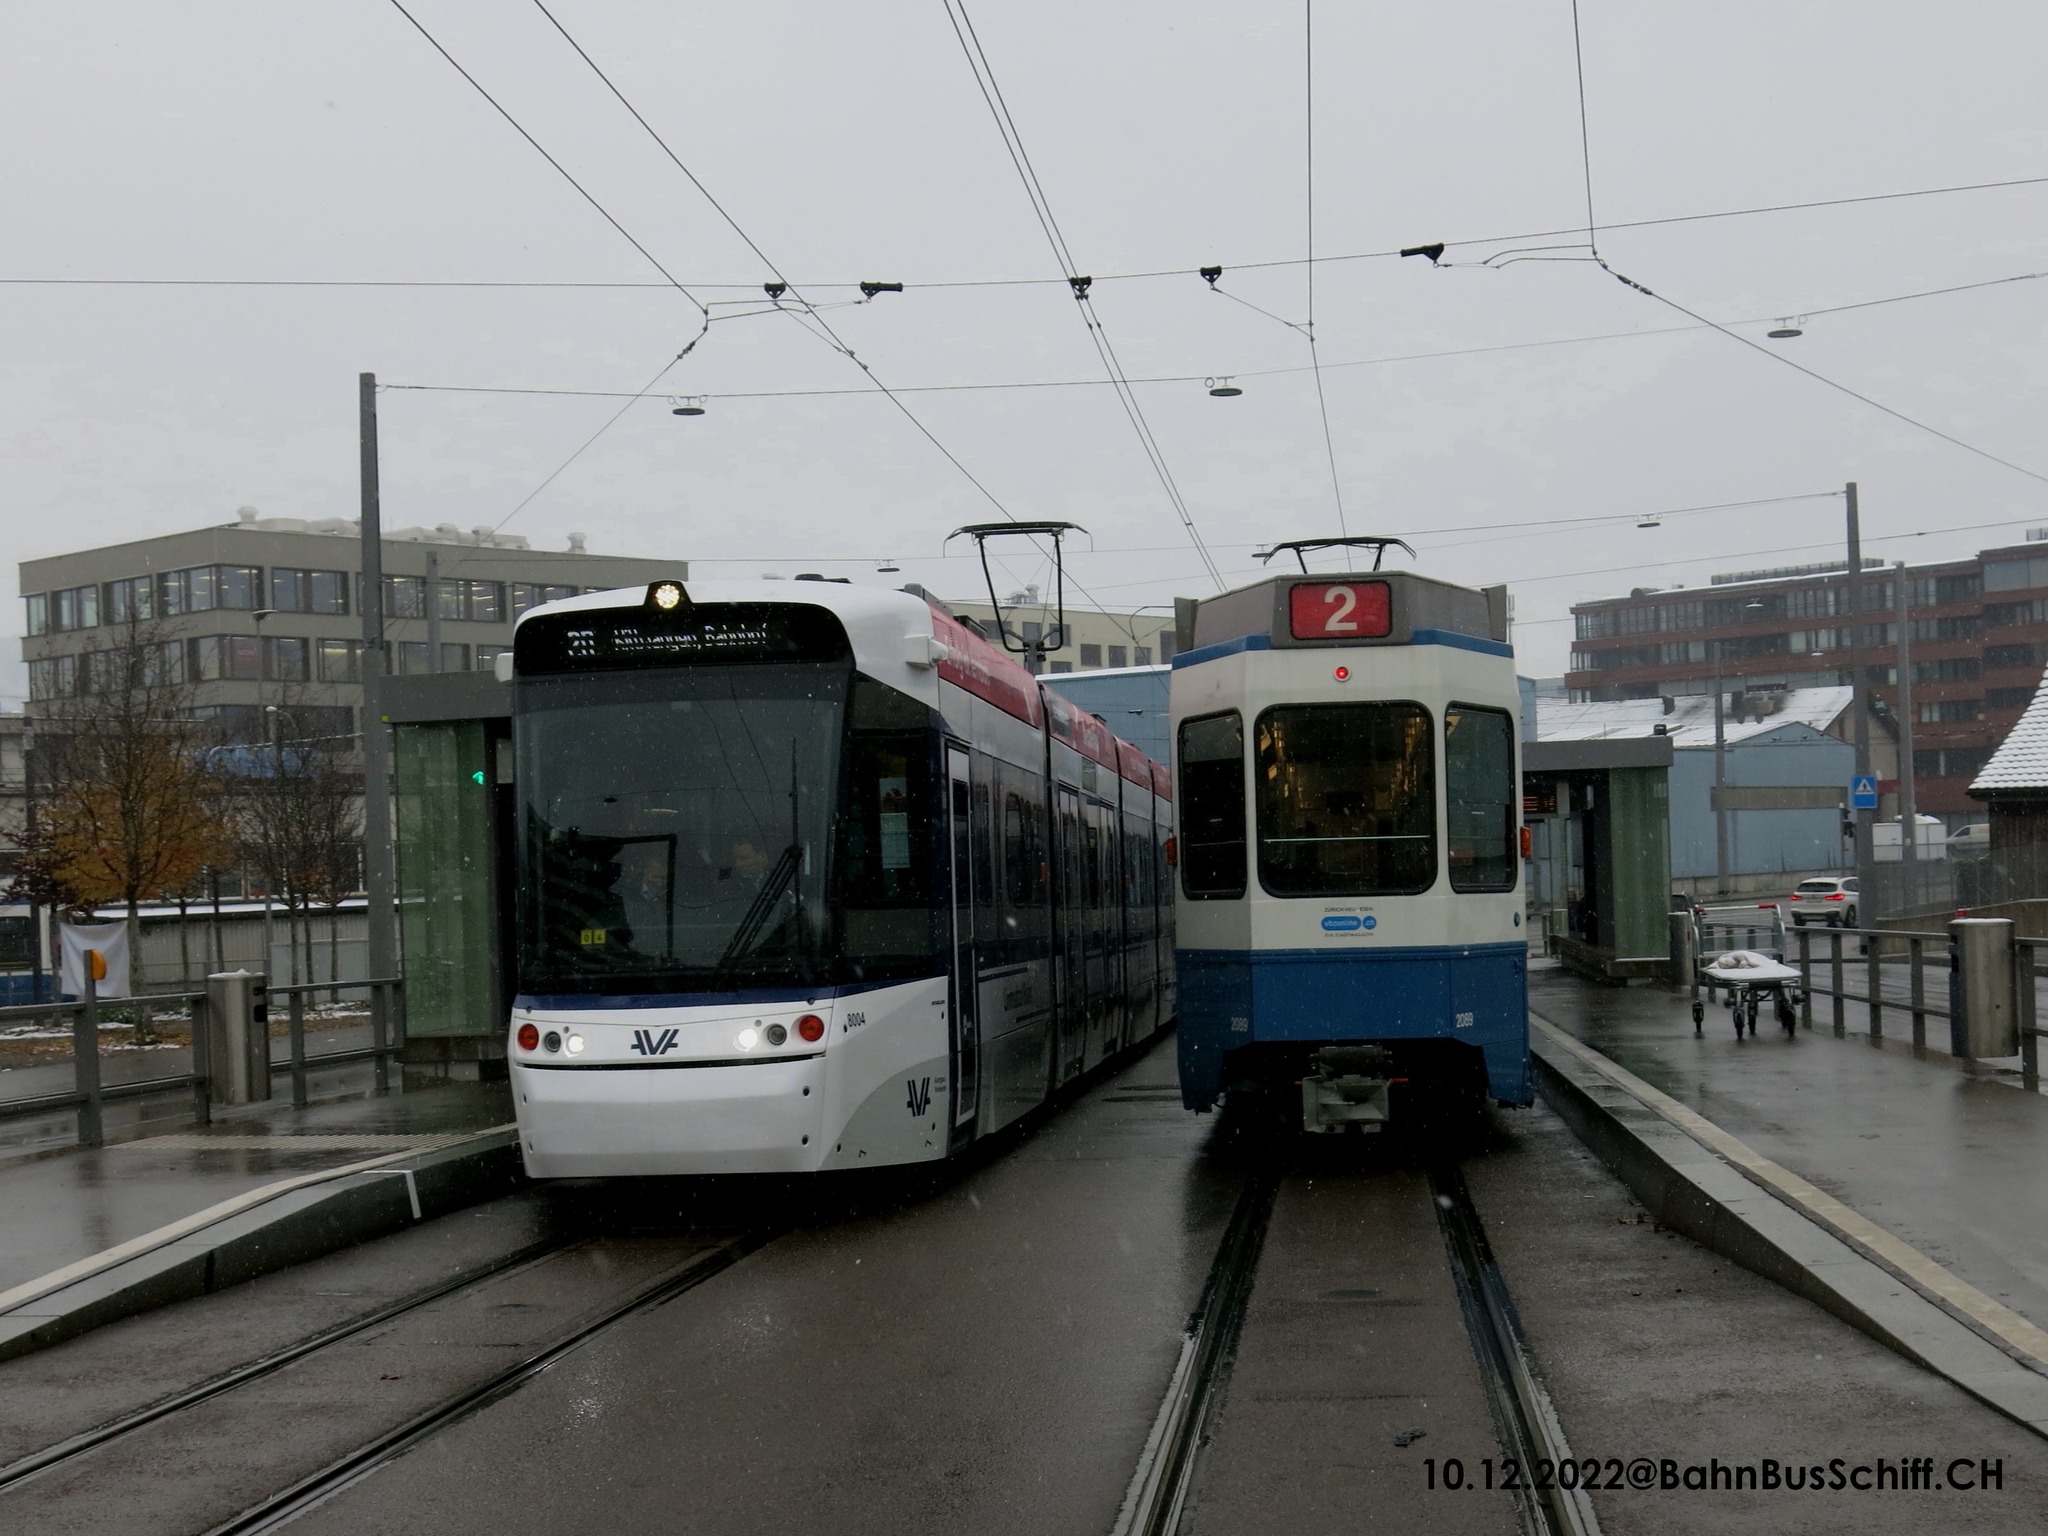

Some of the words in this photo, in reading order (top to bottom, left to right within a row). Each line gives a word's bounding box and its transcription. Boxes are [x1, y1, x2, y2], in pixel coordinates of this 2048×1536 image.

[1324, 586, 1358, 631] 2
[847, 1012, 866, 1027] 8004
[1231, 1017, 1249, 1032] 2089
[1456, 1012, 1474, 1028] 2089
